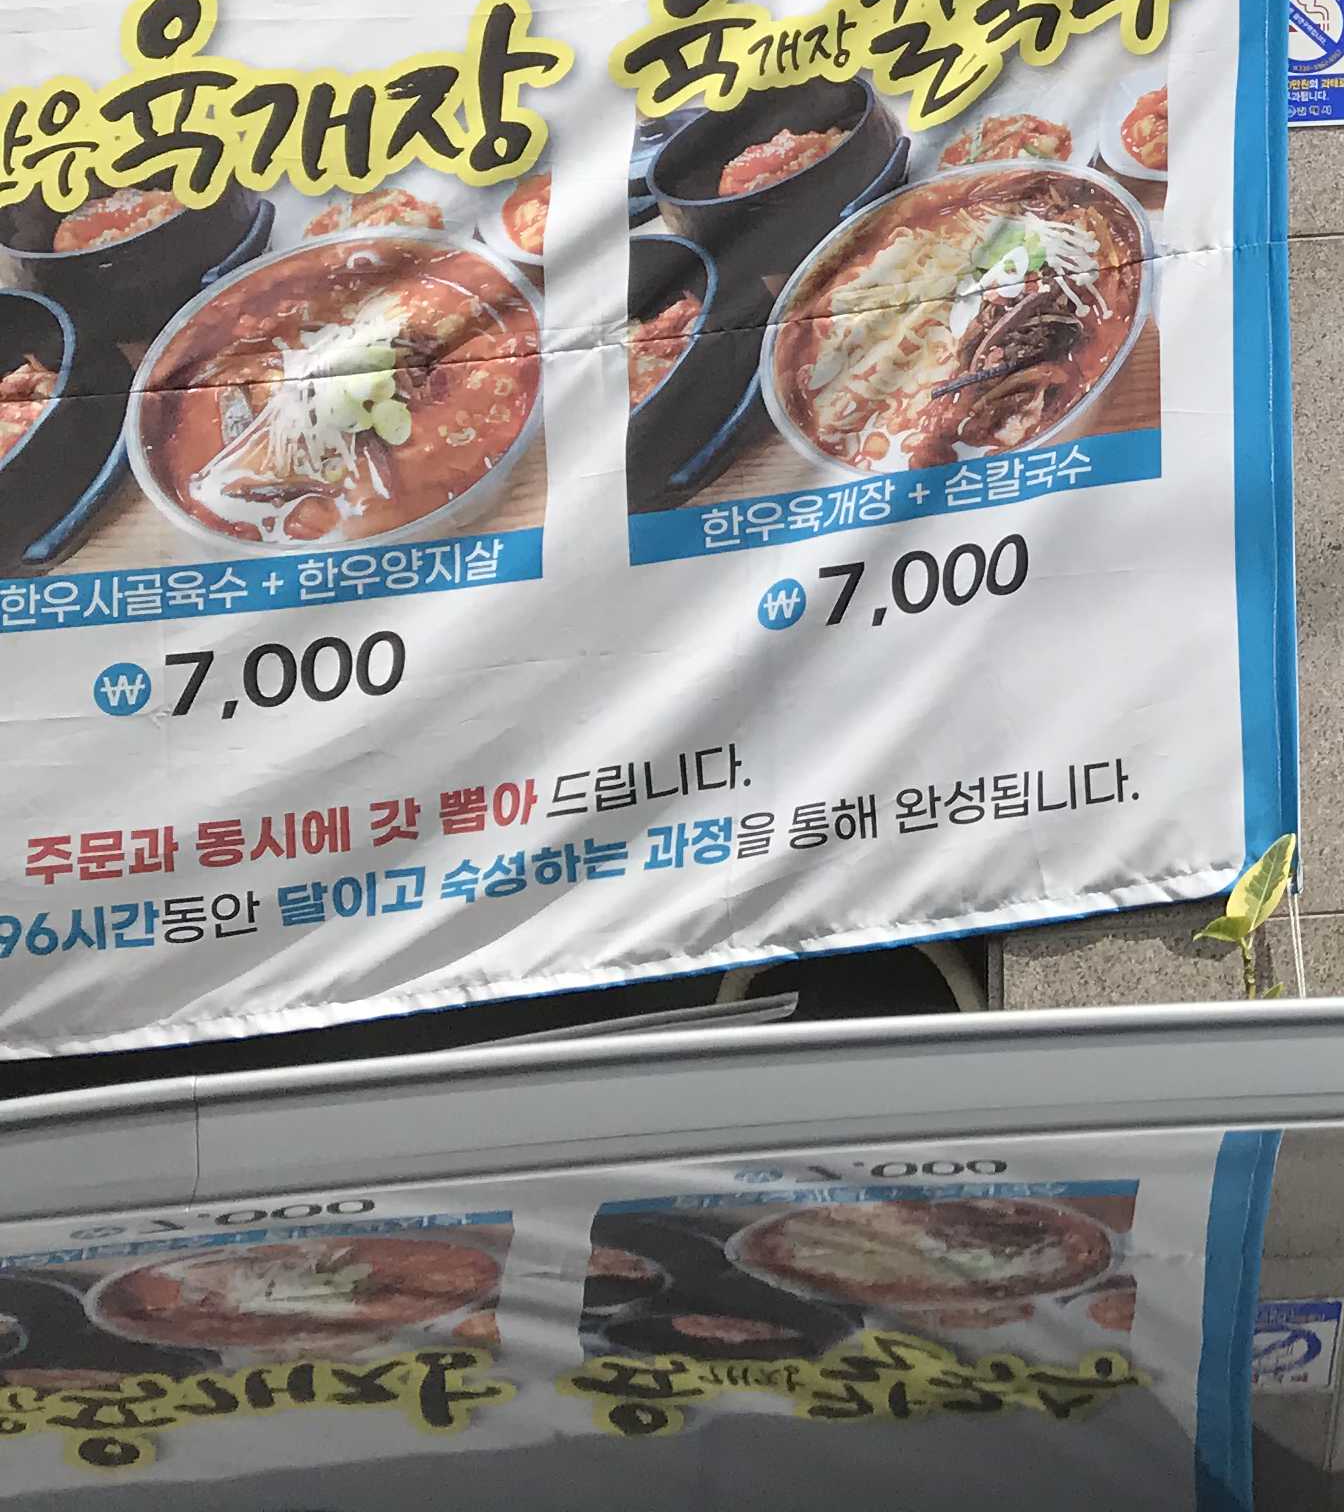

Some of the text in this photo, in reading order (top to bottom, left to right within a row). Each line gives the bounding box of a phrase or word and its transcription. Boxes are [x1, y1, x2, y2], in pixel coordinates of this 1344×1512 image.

[701, 478, 896, 550] 한우육개장
[944, 444, 1093, 506] 손칼국수
[0, 567, 249, 627] 한우사골육수
[297, 539, 505, 601] 한우양지살
[818, 534, 1030, 627] 7,000
[164, 630, 406, 720] 7,000
[0, 758, 1140, 960] 96시간동안 달이고 숙성하는 과정을 통해 완성됩니다.
[25, 743, 752, 884] 주문과 동시에 갓 뽑아 드립니다.
